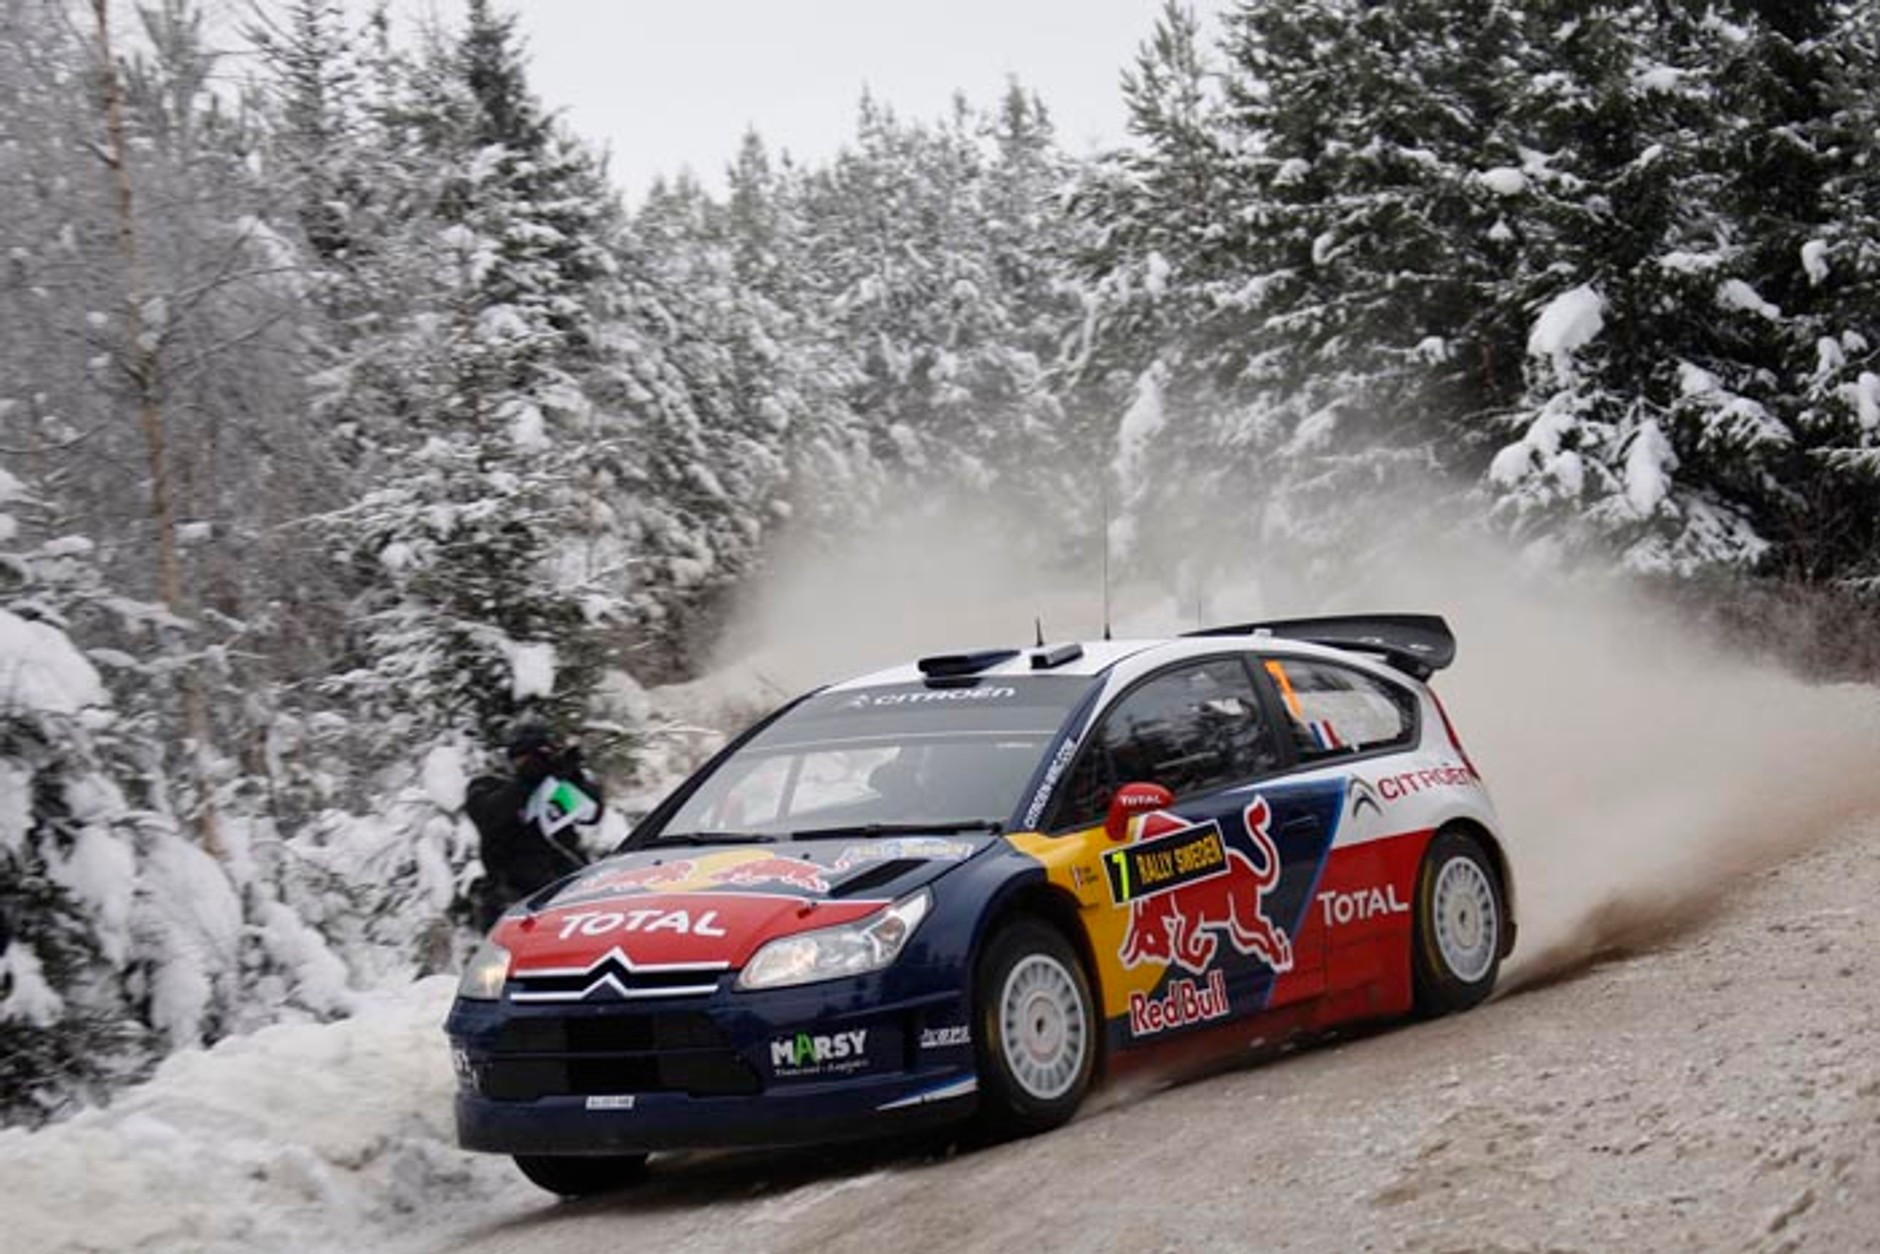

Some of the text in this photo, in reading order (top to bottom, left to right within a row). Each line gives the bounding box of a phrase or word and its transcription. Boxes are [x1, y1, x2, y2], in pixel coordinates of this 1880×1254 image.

[1120, 793, 1163, 806] TOTAL
[1136, 854, 1174, 884] RALLY
[1175, 834, 1222, 872] SWEDEN
[1318, 884, 1410, 925] TOTAL
[558, 908, 726, 940] TOTAL
[770, 1029, 867, 1067] MARSY
